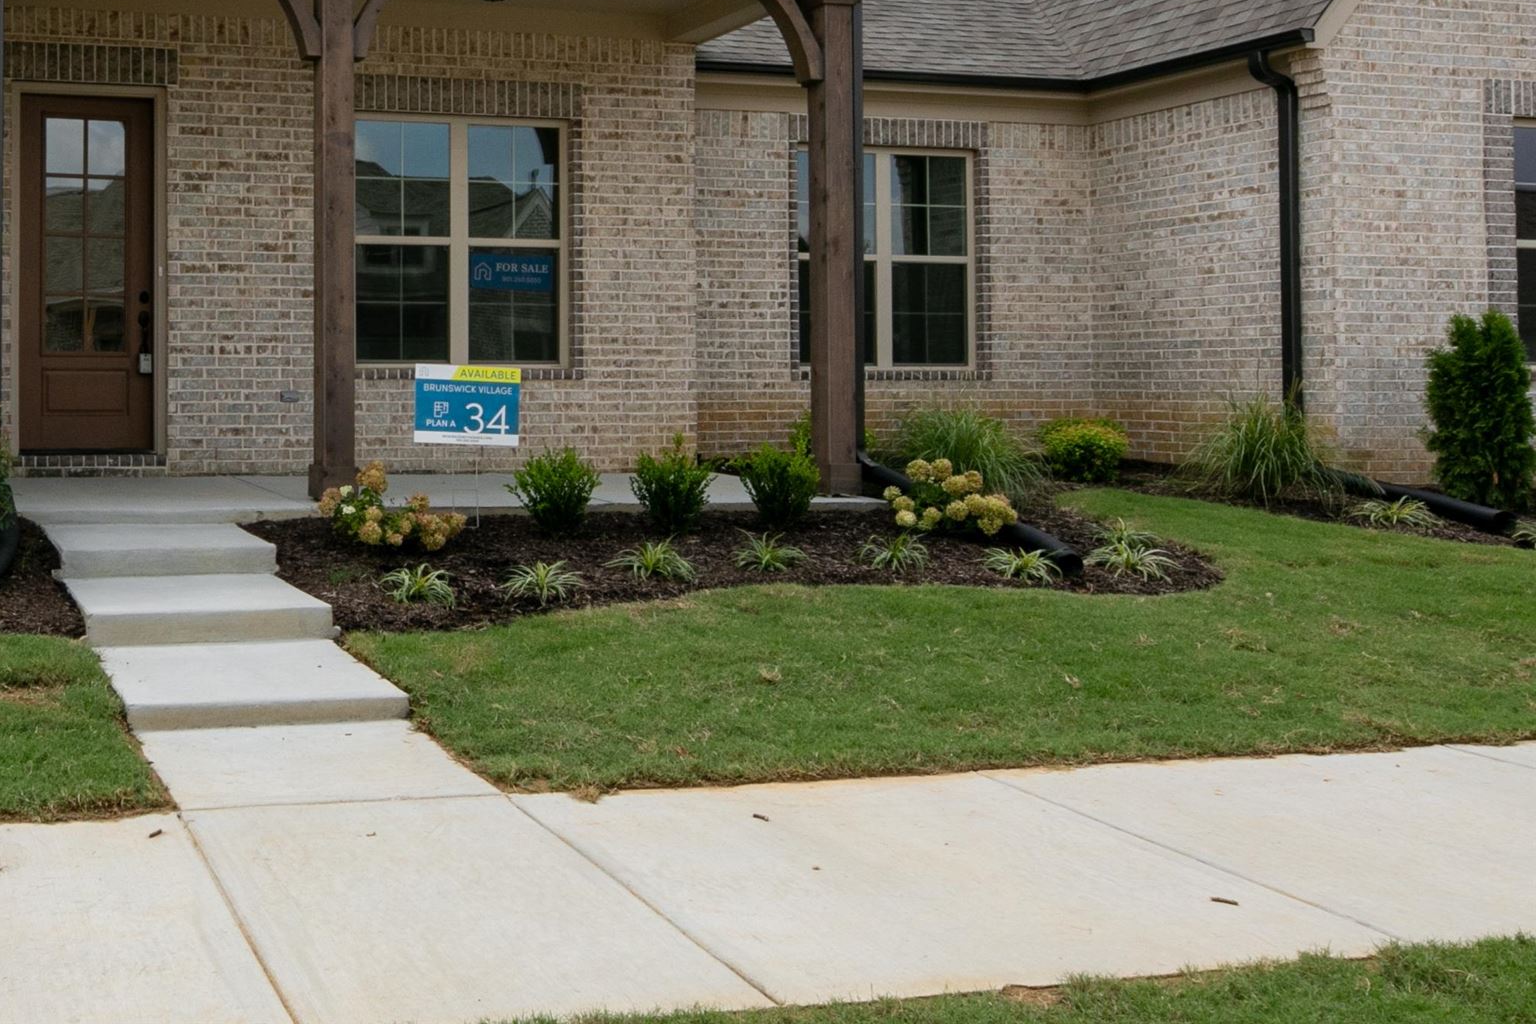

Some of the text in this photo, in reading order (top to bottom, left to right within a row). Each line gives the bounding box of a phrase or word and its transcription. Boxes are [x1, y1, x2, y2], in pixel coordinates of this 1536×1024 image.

[496, 262, 549, 274] FOR SALE
[460, 369, 517, 380] AVAILABLE
[423, 383, 512, 395] BRUNSWICK VILLAGE
[426, 418, 456, 427] PLAN A
[464, 403, 510, 435] 34
